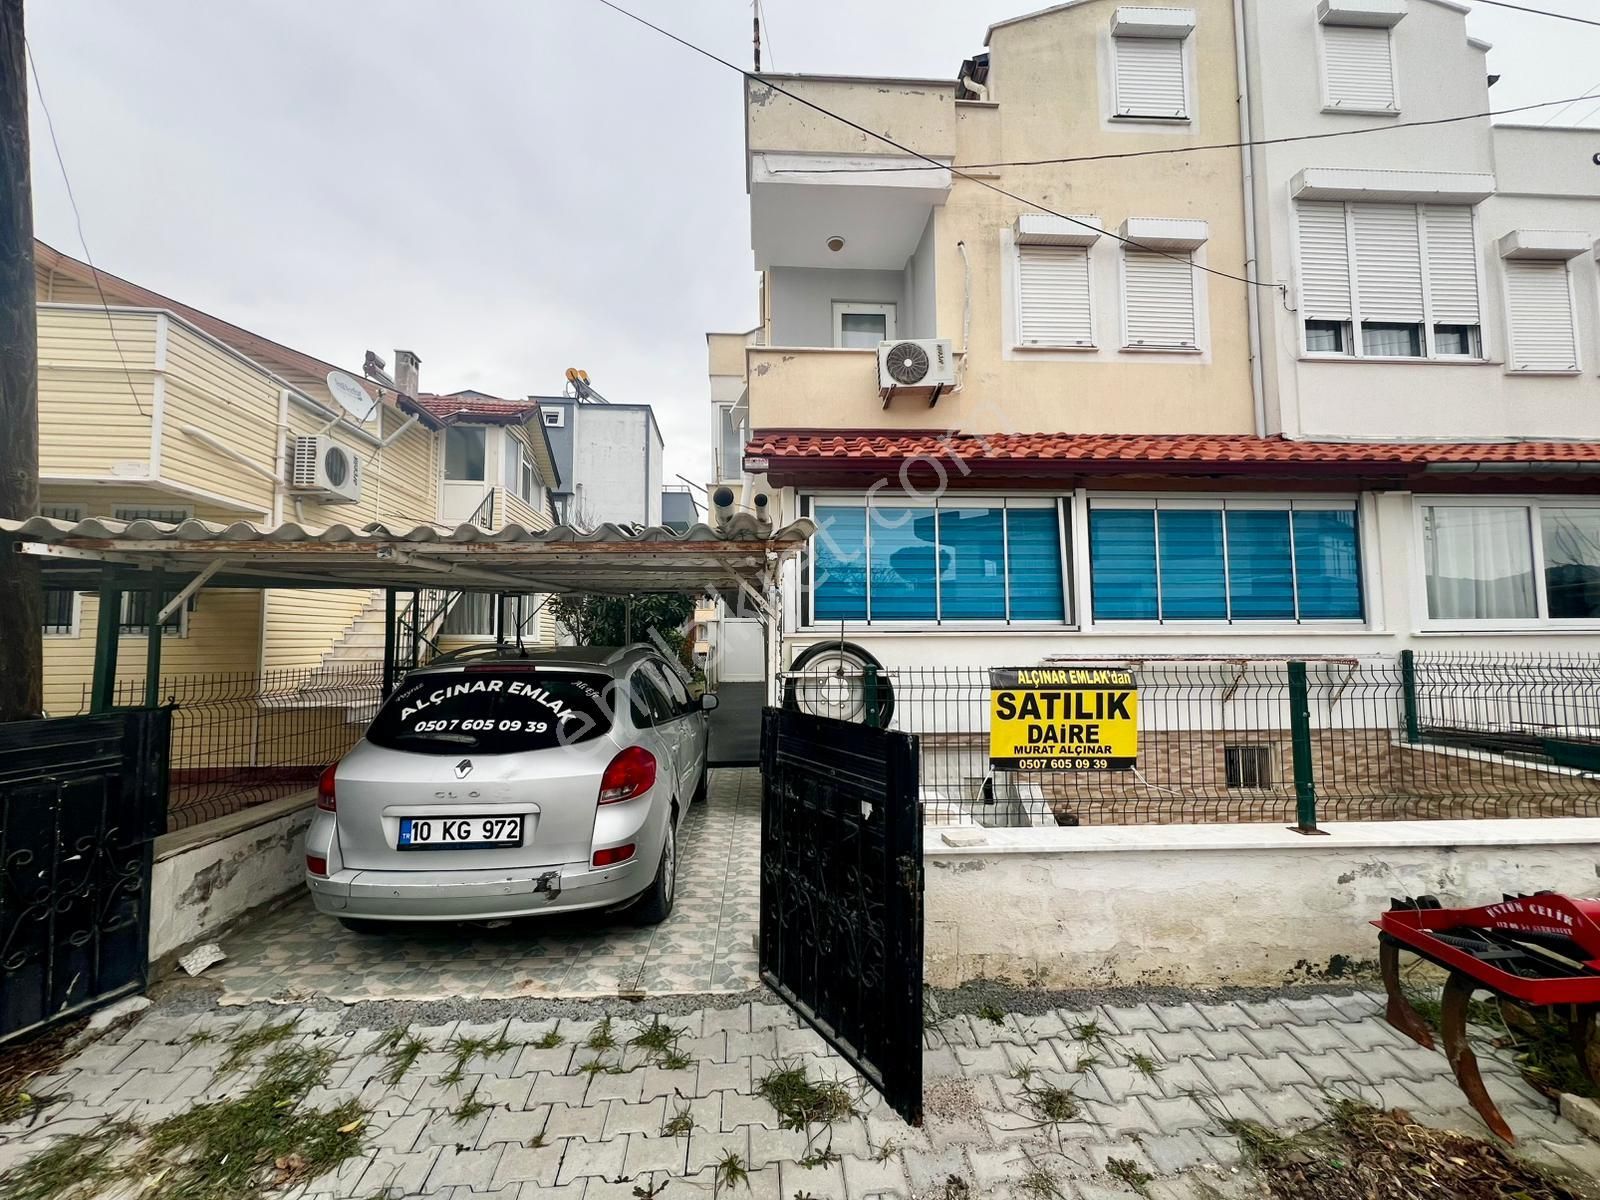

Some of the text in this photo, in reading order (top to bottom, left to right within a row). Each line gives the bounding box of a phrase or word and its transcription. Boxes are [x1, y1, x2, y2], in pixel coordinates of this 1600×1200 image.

[1017, 670, 1131, 688] ALÇINAR EMLAK'dan
[401, 680, 577, 725] ALÇINAR EMLAK
[996, 692, 1130, 720] SATILIK
[414, 719, 547, 733] 0507 605 09 39
[1014, 745, 1112, 756] MURAT ALÇINAR
[1019, 759, 1108, 769] 0507 605 09 39
[412, 821, 431, 841] 10
[442, 821, 471, 840] KG
[482, 819, 519, 839] 972
